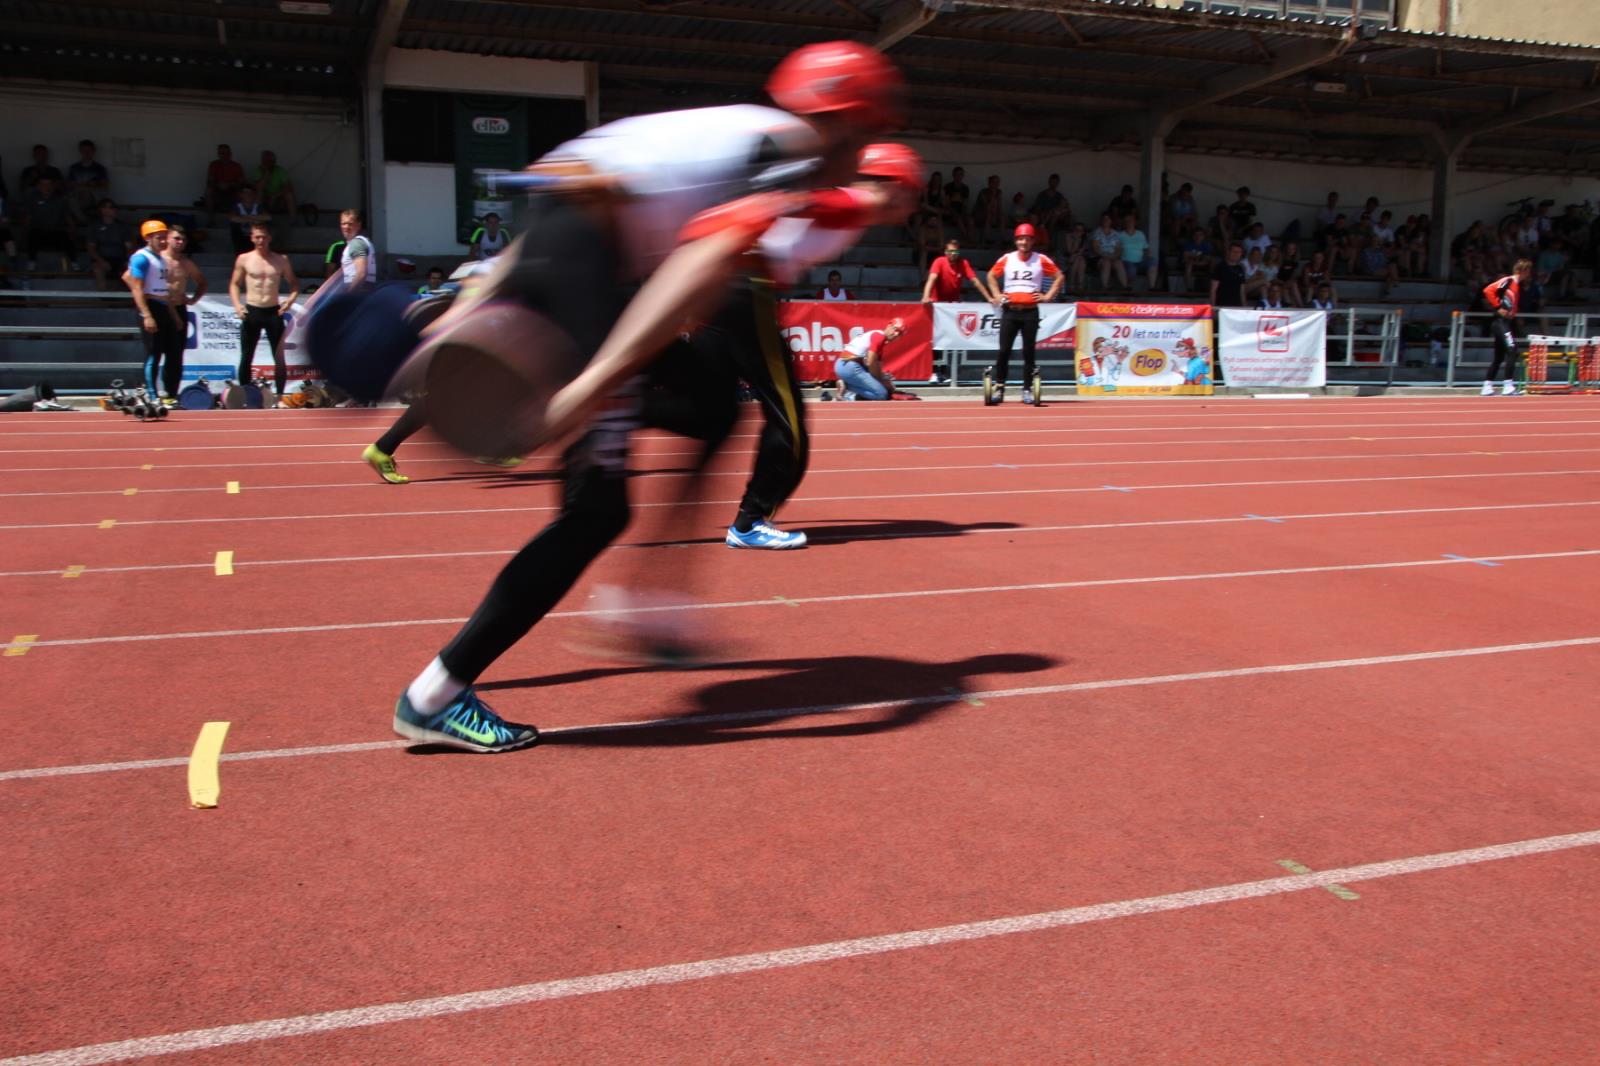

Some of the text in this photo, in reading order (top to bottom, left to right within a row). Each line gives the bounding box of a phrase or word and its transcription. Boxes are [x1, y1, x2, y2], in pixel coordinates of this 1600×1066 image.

[476, 119, 505, 131] elko
[1011, 270, 1033, 281] 12
[203, 332, 241, 341] MINISTE
[1112, 325, 1181, 339] 20 let na trhu
[203, 342, 238, 351] VNITRA
[1135, 355, 1163, 371] Flop
